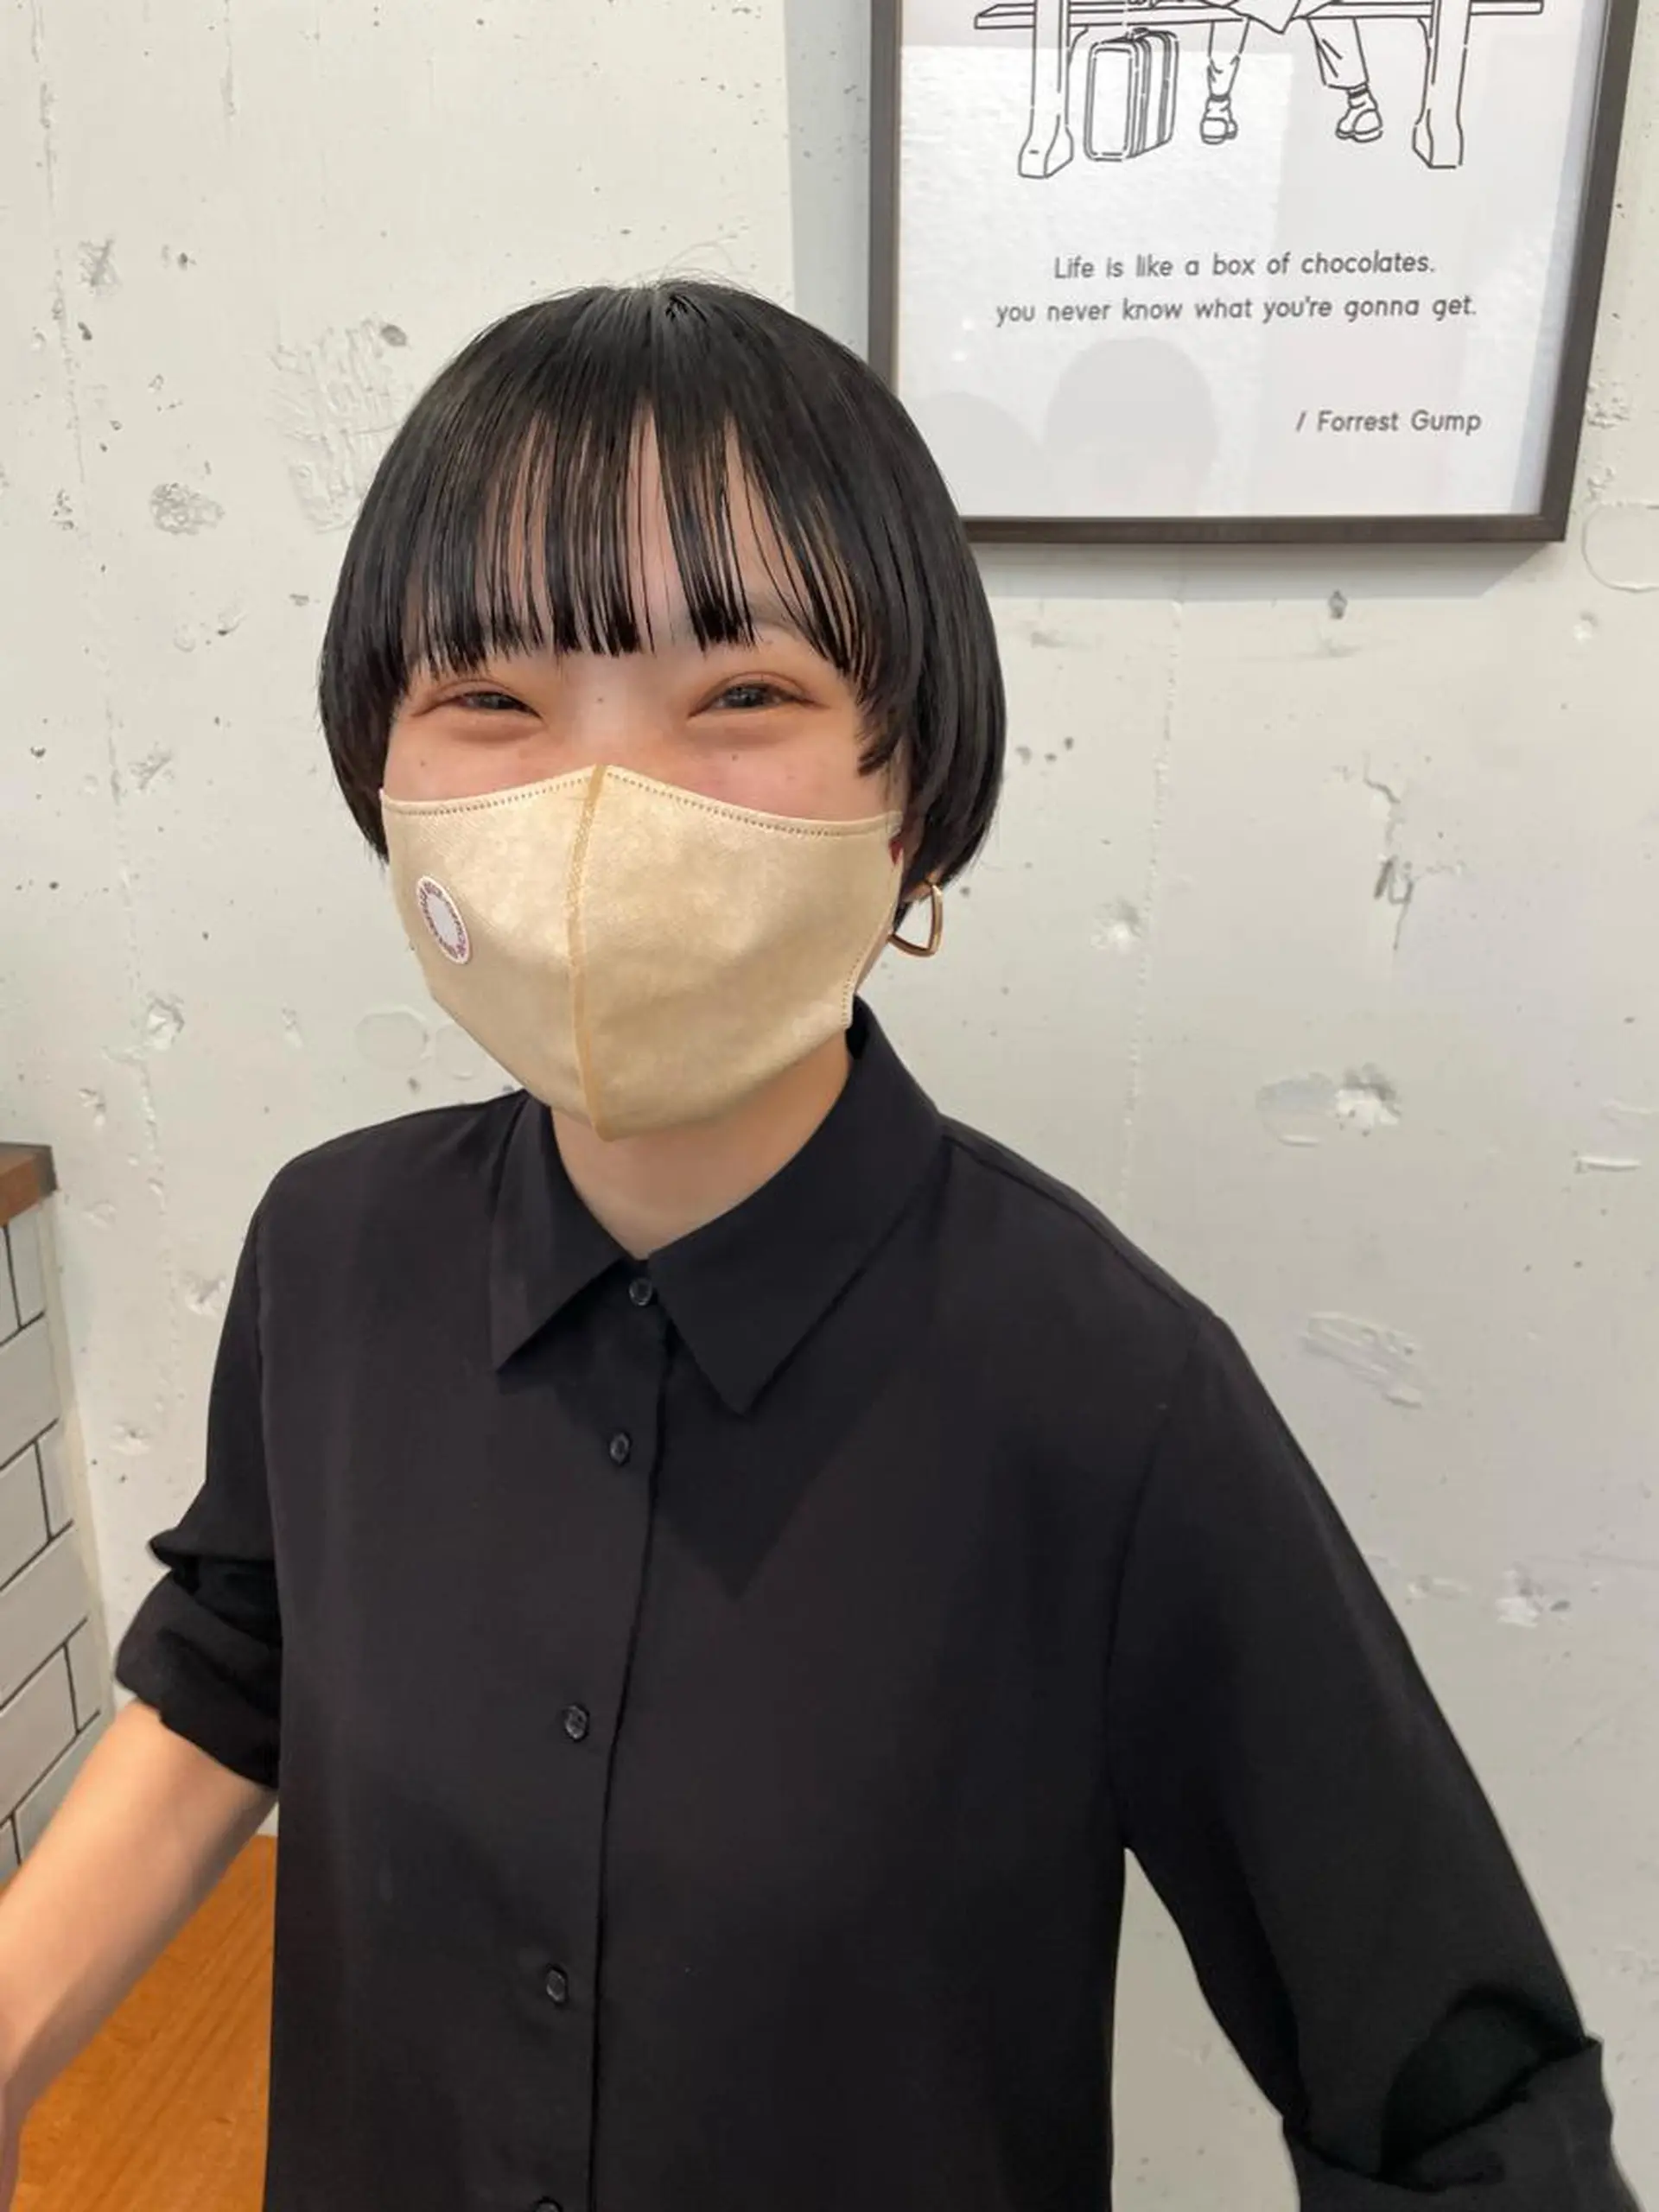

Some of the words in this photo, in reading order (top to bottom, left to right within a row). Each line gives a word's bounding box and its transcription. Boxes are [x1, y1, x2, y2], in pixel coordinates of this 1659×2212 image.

[1054, 256, 1096, 279] Life
[1106, 256, 1124, 278] is
[1136, 254, 1174, 277] like
[1185, 260, 1200, 276] a
[1212, 253, 1255, 276] box
[1266, 251, 1292, 276] of
[1300, 250, 1435, 275] chocolates.
[996, 305, 1035, 327] you
[1047, 304, 1111, 321] never
[1122, 298, 1184, 321] know
[1195, 297, 1253, 319] what
[1262, 296, 1333, 324] you're
[1344, 298, 1421, 323] gonna
[1432, 295, 1478, 321] get.
[1317, 410, 1400, 432] Forrest
[1410, 410, 1483, 435] Gump
